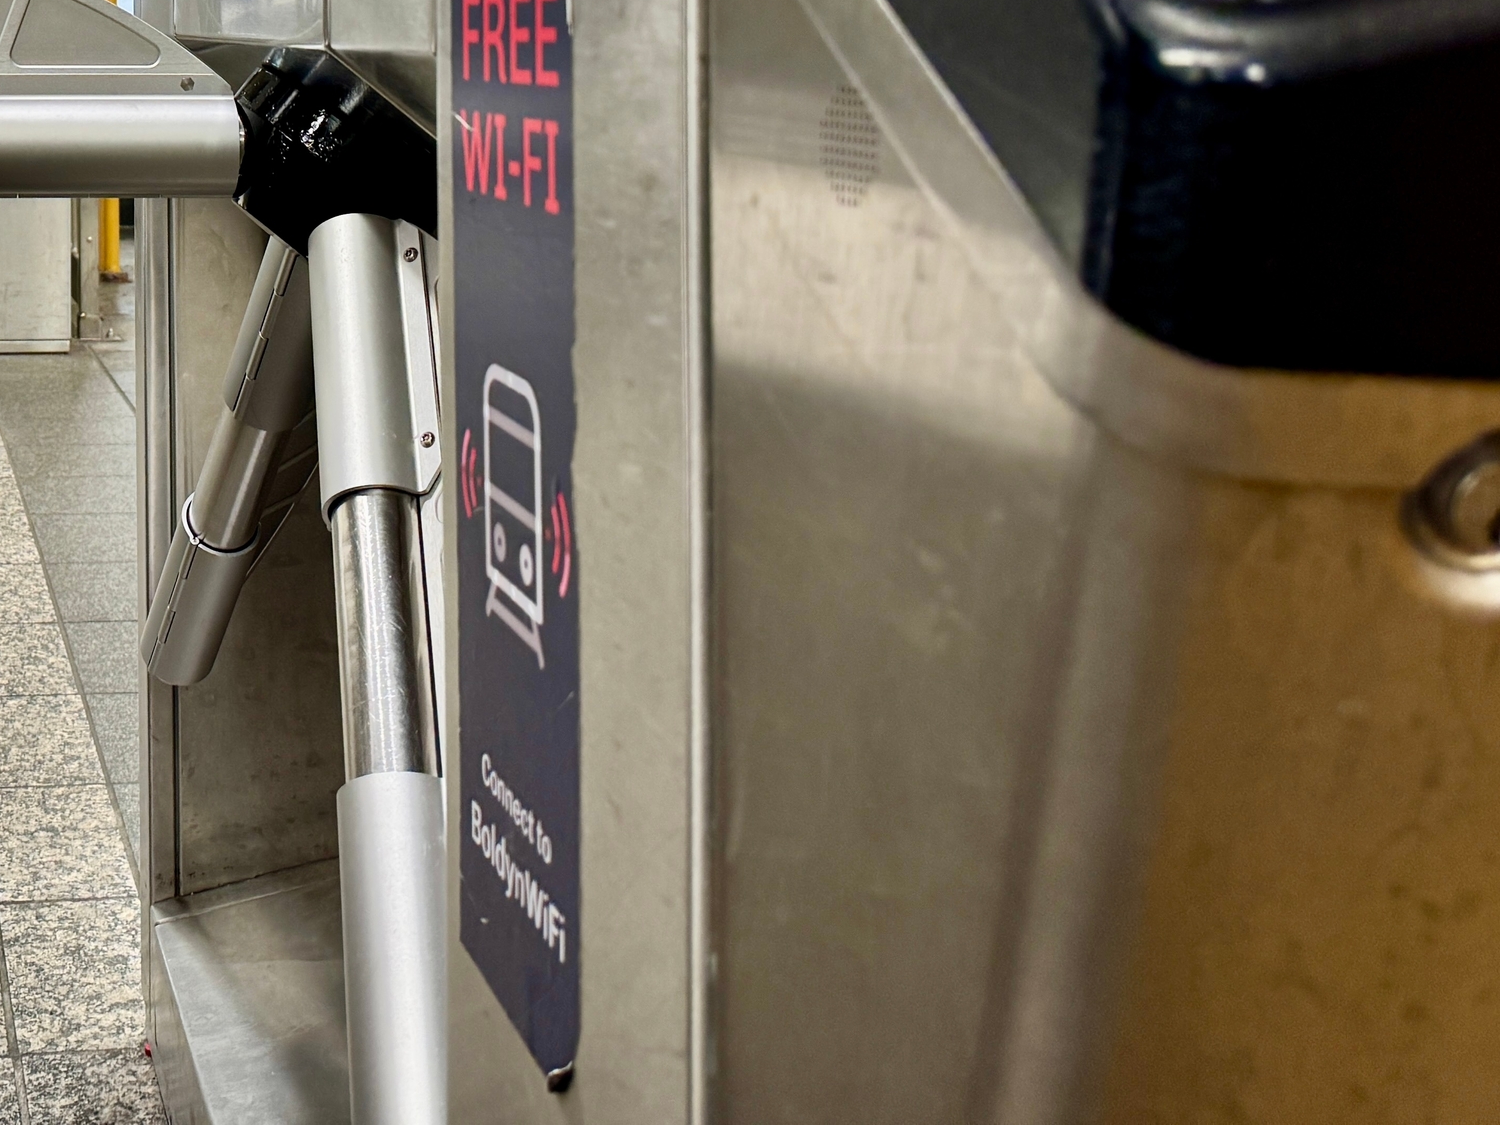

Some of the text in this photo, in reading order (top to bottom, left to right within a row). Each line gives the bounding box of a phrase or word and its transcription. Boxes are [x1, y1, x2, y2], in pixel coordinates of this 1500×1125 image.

[460, 108, 561, 216] WI-FI
[480, 752, 553, 865] Connect to
[471, 799, 566, 964] BoldynWiFi
